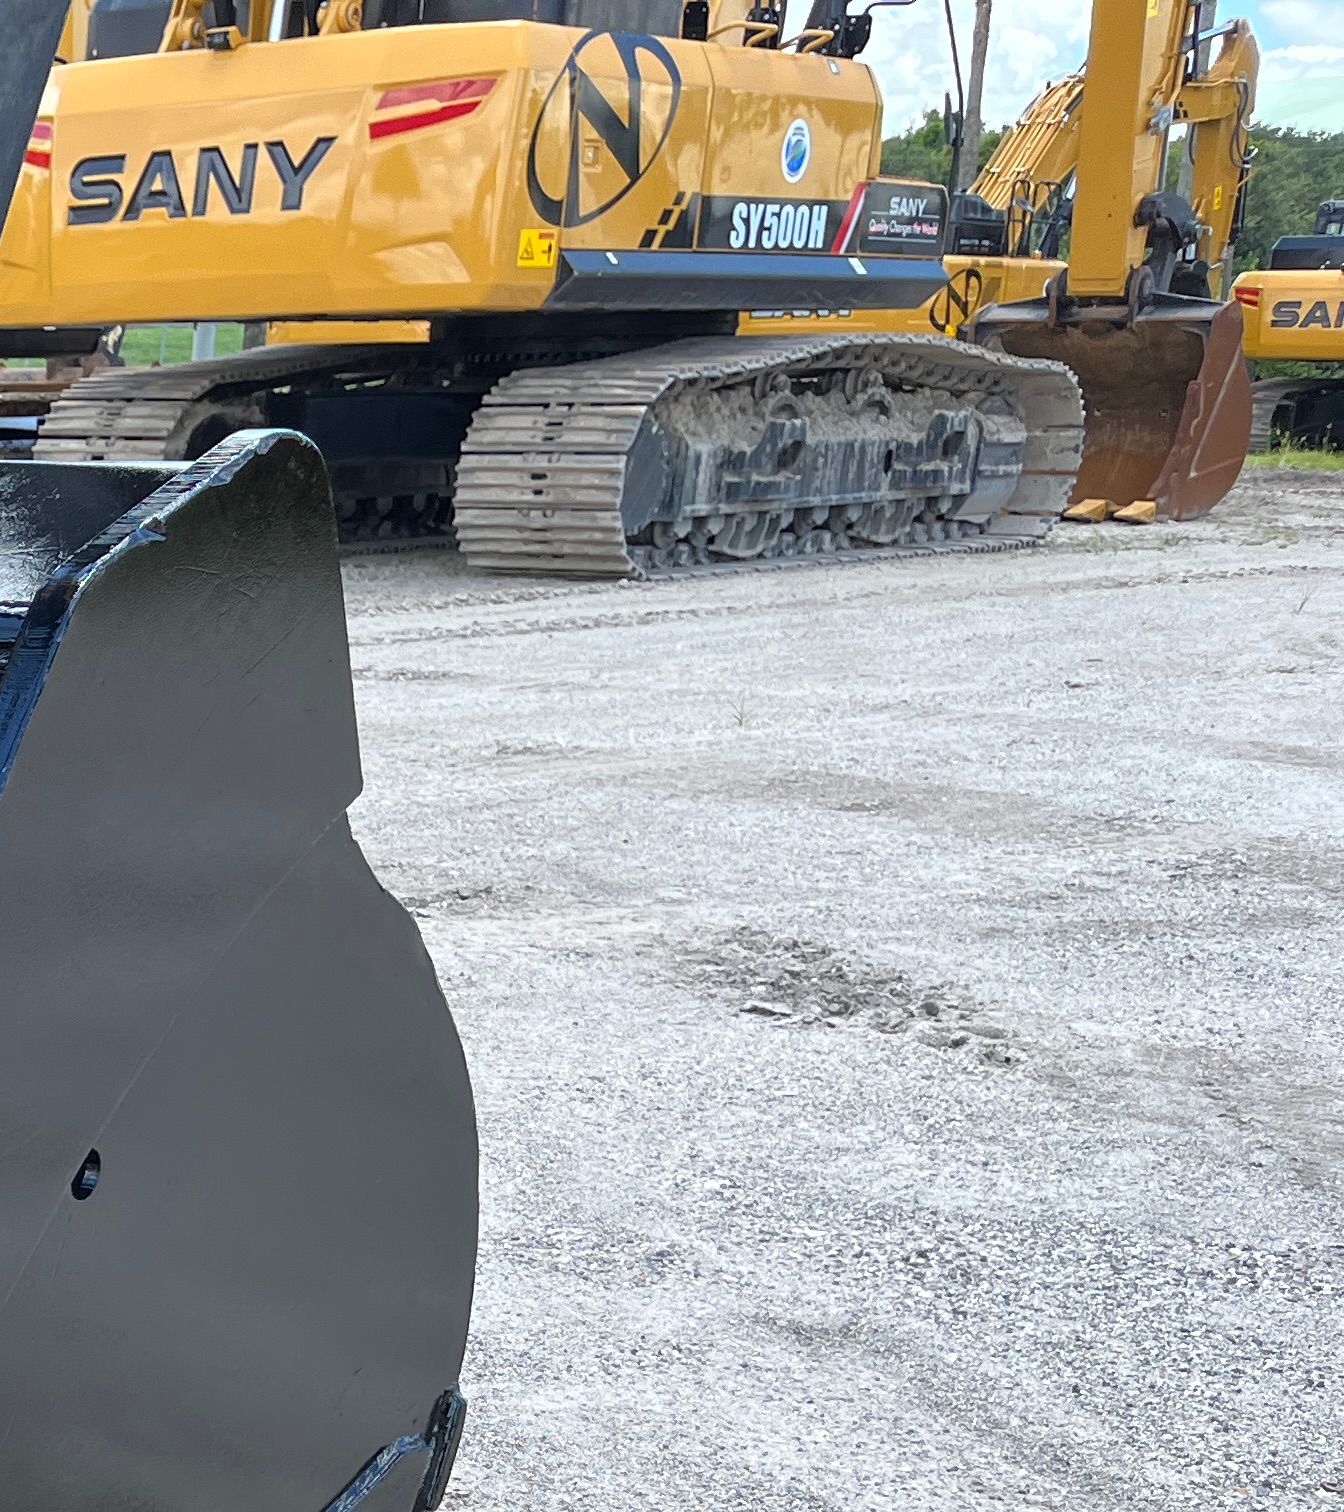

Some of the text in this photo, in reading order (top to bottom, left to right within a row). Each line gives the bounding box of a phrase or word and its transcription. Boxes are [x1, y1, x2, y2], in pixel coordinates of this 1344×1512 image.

[66, 135, 340, 226] SANY
[889, 196, 928, 217] SANY
[729, 202, 829, 250] SY500H
[1270, 300, 1344, 329] SA
